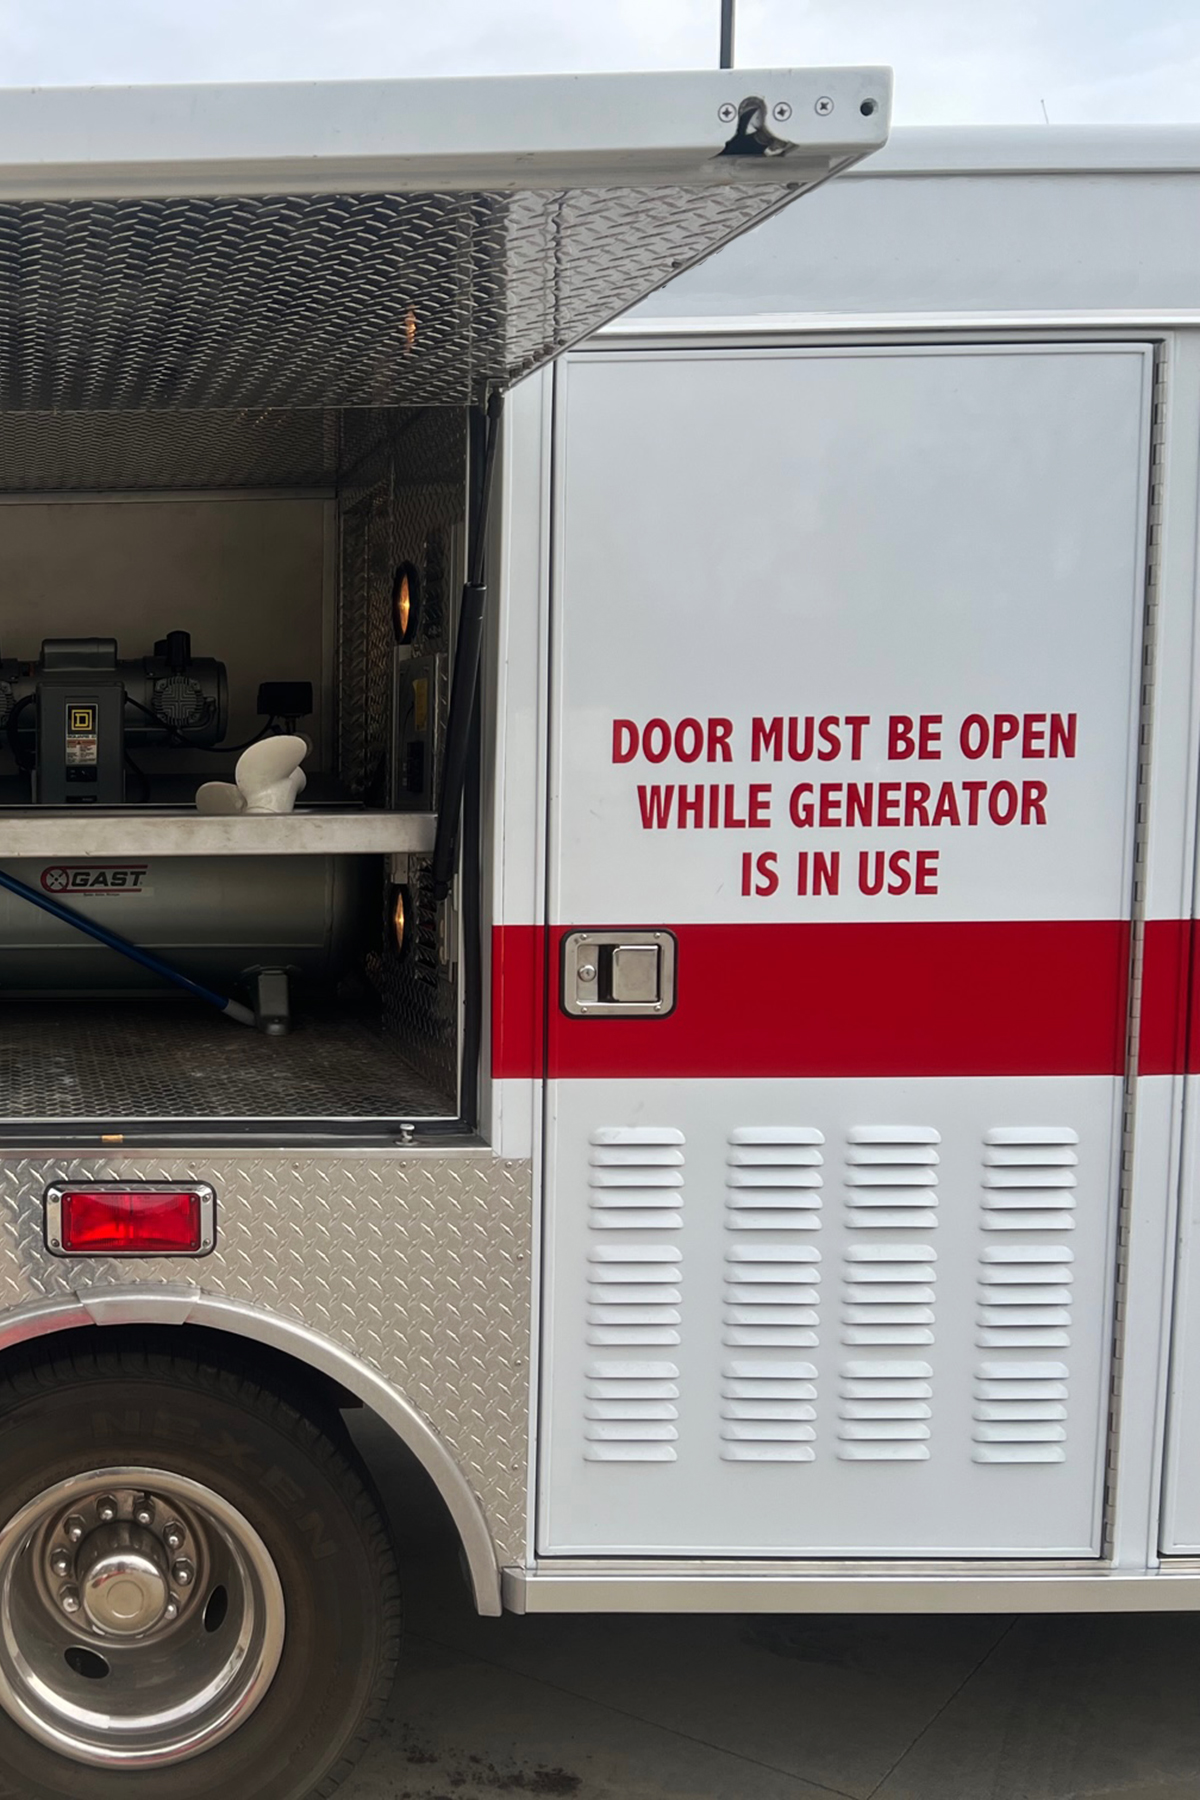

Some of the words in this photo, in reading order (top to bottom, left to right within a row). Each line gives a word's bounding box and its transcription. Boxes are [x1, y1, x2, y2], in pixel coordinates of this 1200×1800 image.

[612, 718, 733, 764] DOOR
[751, 715, 870, 762] MUST
[887, 715, 943, 760] BE
[959, 713, 1077, 760] OPEN
[637, 783, 772, 830] WHILE
[789, 780, 1048, 828] GENERATOR
[71, 871, 147, 888] GAST
[741, 851, 780, 897] IS
[797, 851, 840, 896] IN
[858, 849, 940, 896] USE
[90, 1408, 339, 1560] NEXEN
